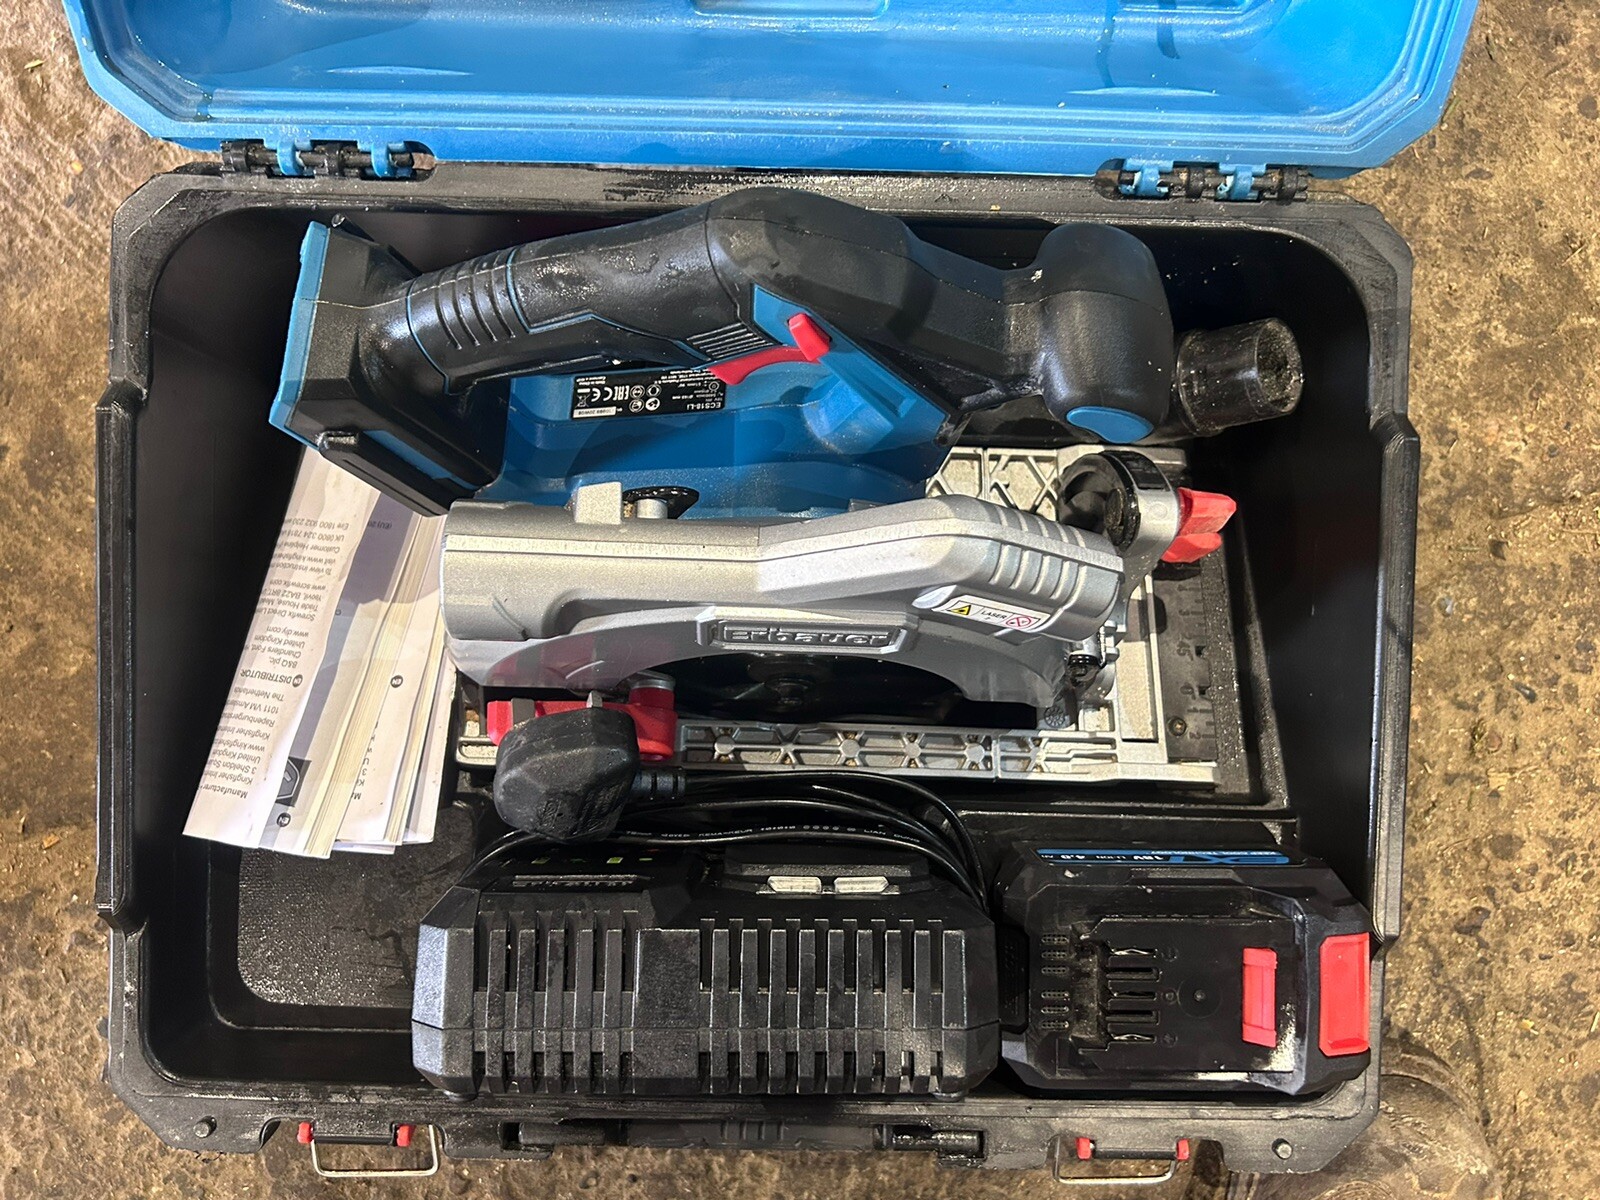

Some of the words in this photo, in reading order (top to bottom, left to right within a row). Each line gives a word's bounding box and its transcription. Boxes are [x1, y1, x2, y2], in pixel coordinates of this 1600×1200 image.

[310, 544, 340, 554] Customer
[300, 602, 318, 612] Trade
[267, 608, 287, 618] Direct
[288, 610, 316, 622] Screwfix
[981, 610, 1008, 620] LASER
[254, 634, 283, 644] Kingdom
[283, 638, 305, 649] United
[267, 646, 301, 660] Chandlers
[282, 658, 298, 669] B&Q
[240, 669, 292, 685] DISTRIBUTOR
[272, 692, 284, 702] The
[250, 702, 262, 712] VM
[264, 702, 280, 714] 1011
[236, 728, 270, 740] Kingfisher
[237, 752, 260, 764] United
[222, 761, 250, 774] Sheldon
[251, 766, 257, 774] 3
[218, 772, 253, 786] Kingfisher
